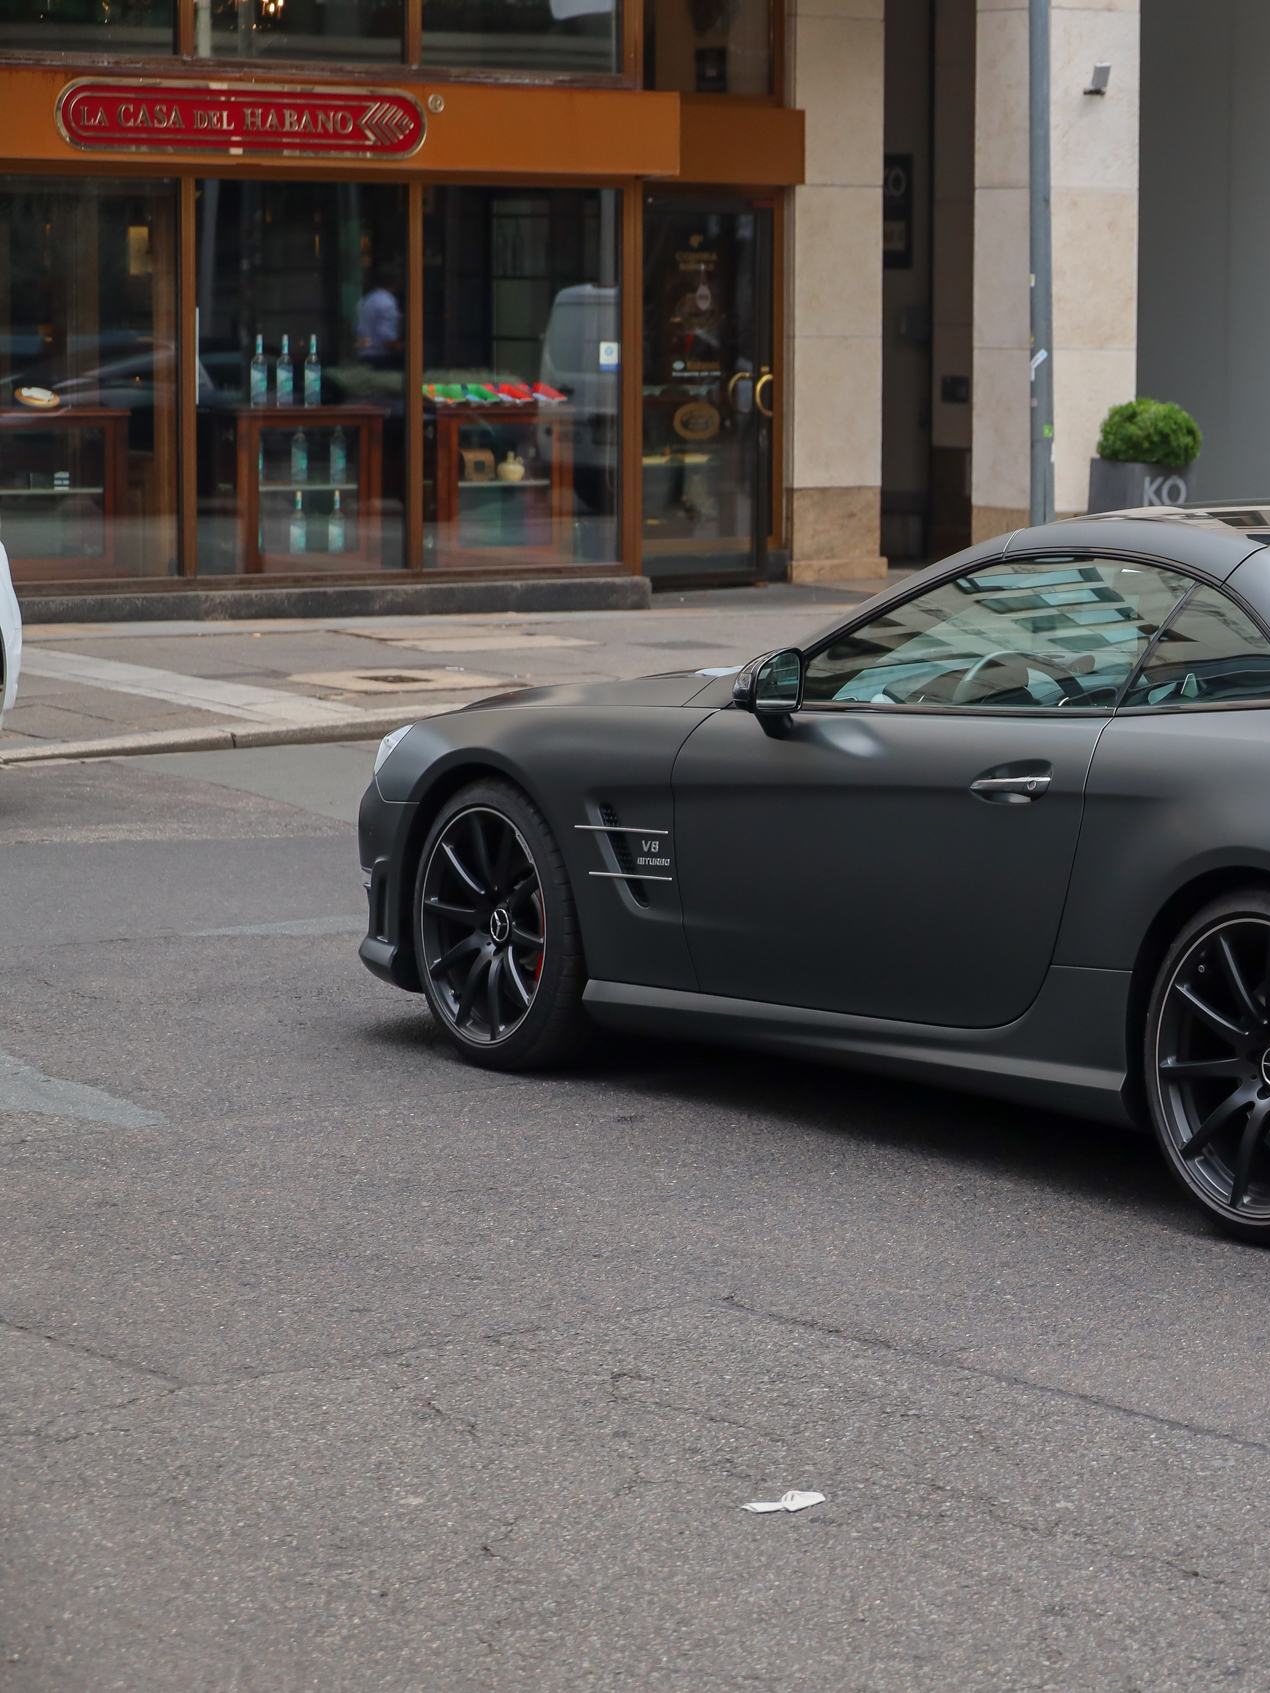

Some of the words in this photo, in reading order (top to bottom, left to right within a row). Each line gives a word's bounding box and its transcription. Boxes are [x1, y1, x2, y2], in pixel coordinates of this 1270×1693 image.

[79, 105, 109, 127] LA
[117, 103, 185, 130] CASA
[193, 109, 235, 131] DEL
[243, 107, 354, 135] HABANO
[641, 840, 660, 853] V8
